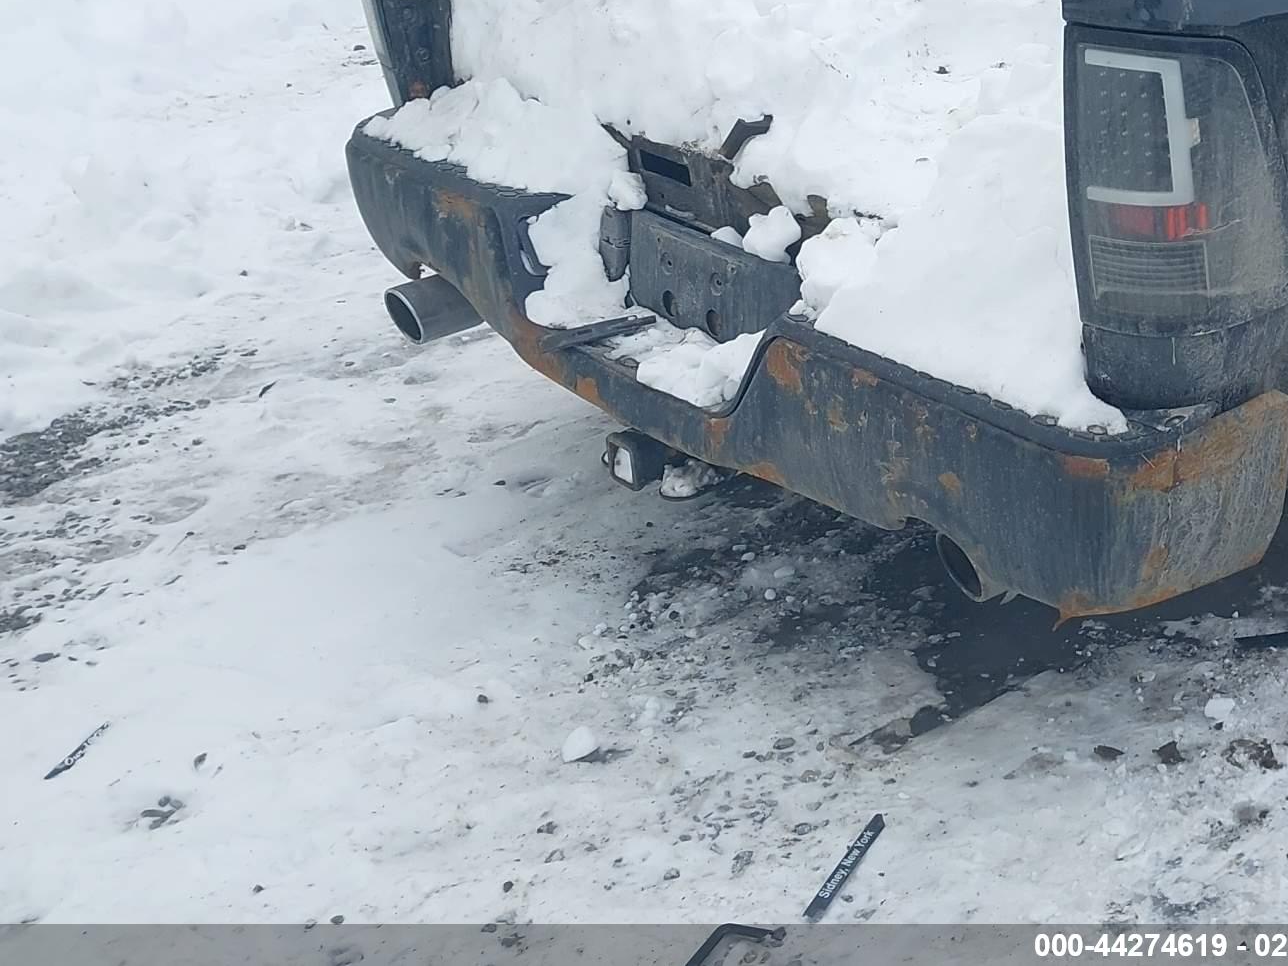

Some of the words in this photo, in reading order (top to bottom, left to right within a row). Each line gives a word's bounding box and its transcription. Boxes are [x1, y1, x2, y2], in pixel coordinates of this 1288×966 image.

[818, 868, 850, 900] Sidney,
[841, 848, 861, 867] New
[854, 830, 875, 848] York
